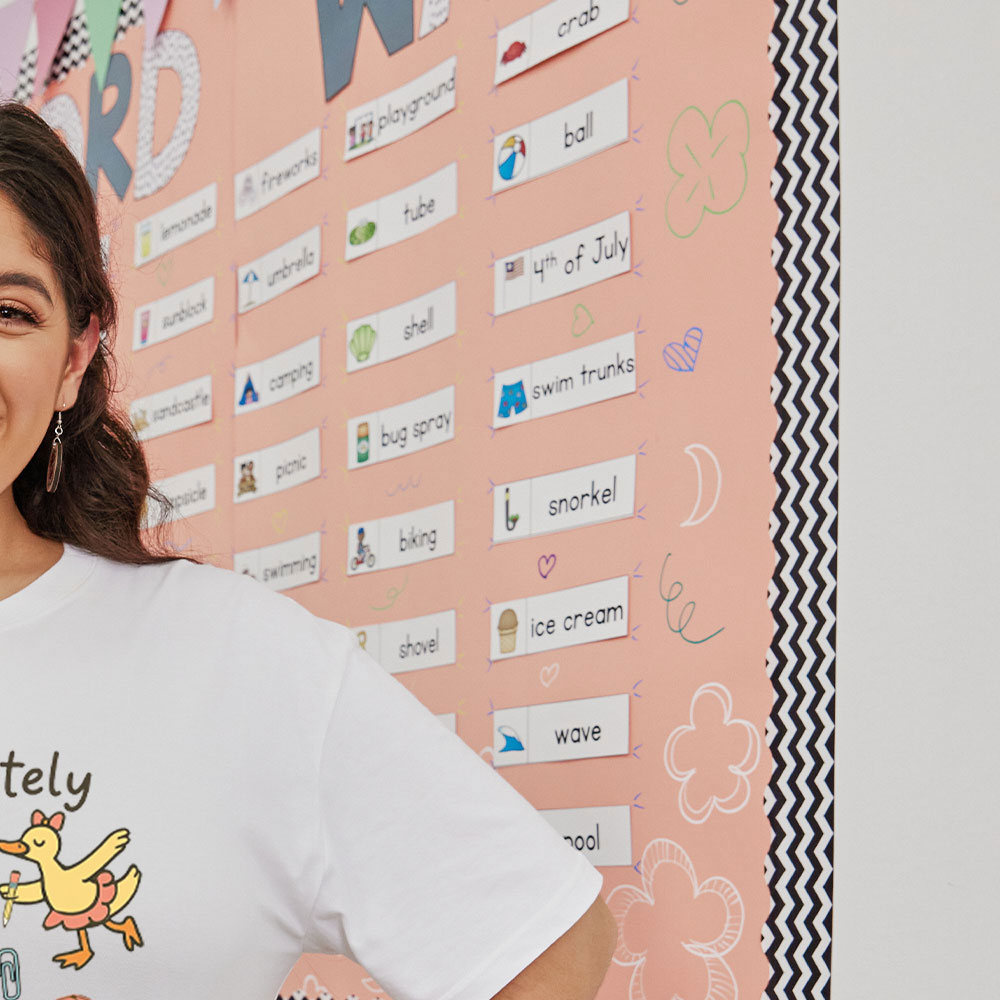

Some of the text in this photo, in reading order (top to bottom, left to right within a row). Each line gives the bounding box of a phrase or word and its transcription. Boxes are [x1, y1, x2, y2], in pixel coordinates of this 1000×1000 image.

[557, 0, 600, 38] crab
[377, 65, 456, 136] playground
[563, 109, 594, 150] ball
[260, 147, 318, 194] fireworks
[159, 199, 213, 241] lemonade
[402, 193, 436, 226] tube
[267, 246, 315, 288] umbrella
[533, 230, 630, 284] 4th of July
[162, 291, 207, 330] sunblock
[402, 305, 435, 342] shell
[268, 358, 315, 393] camping
[531, 352, 635, 400] swim trunks
[380, 410, 453, 449] bug spray
[276, 453, 308, 484] picnic
[548, 474, 617, 517] snorkel
[399, 528, 437, 553] biking
[263, 552, 318, 583] swimming
[530, 603, 624, 638] ice cream
[399, 627, 440, 659] shovel
[554, 723, 602, 745] wave
